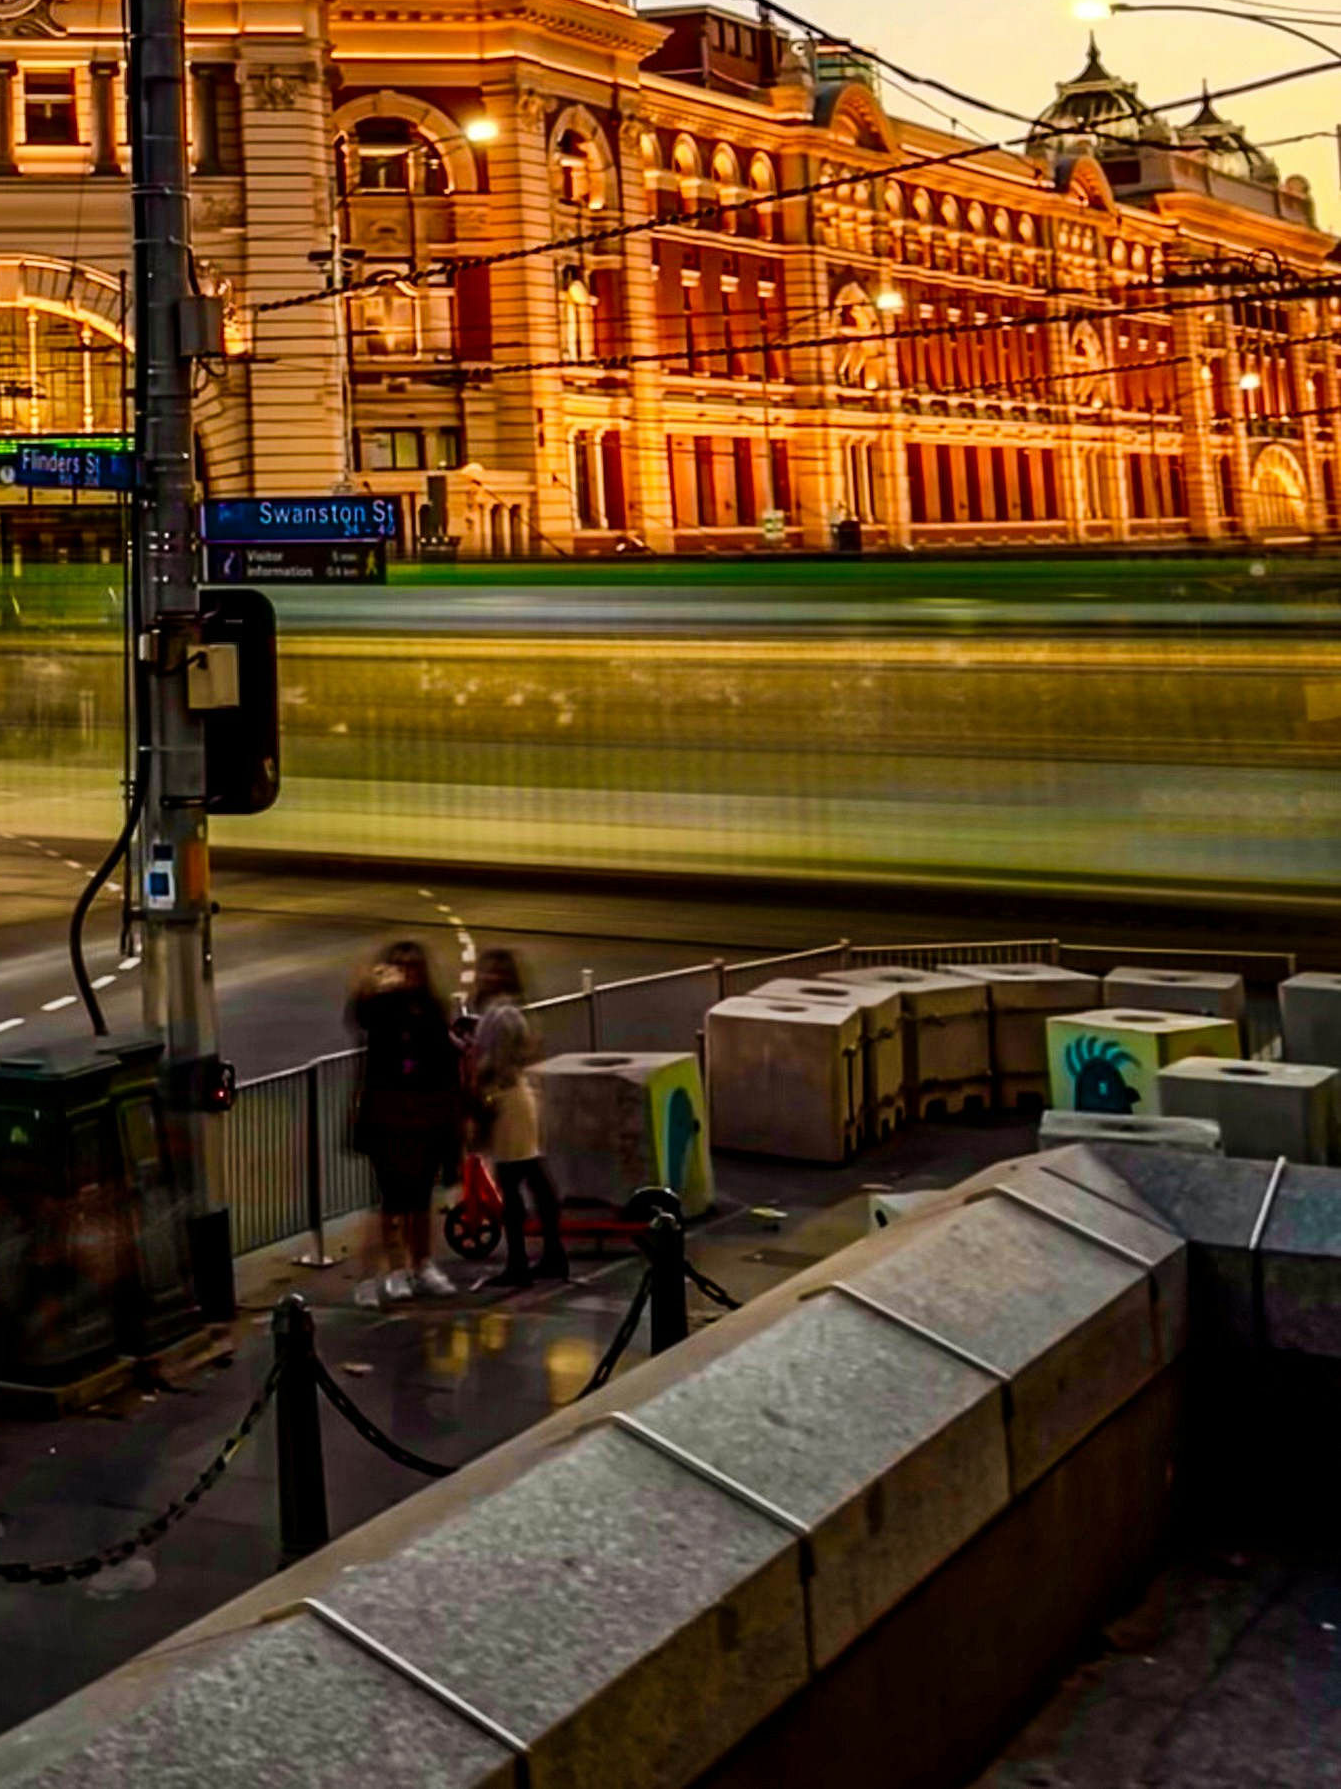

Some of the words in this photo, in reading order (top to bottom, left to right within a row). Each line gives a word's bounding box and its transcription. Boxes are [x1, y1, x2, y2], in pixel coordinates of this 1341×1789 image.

[22, 449, 80, 473] Flinders
[85, 452, 99, 473] St
[259, 501, 366, 524] Swanston
[372, 500, 394, 523] St
[246, 550, 284, 562] Visitor
[247, 565, 314, 578] Information
